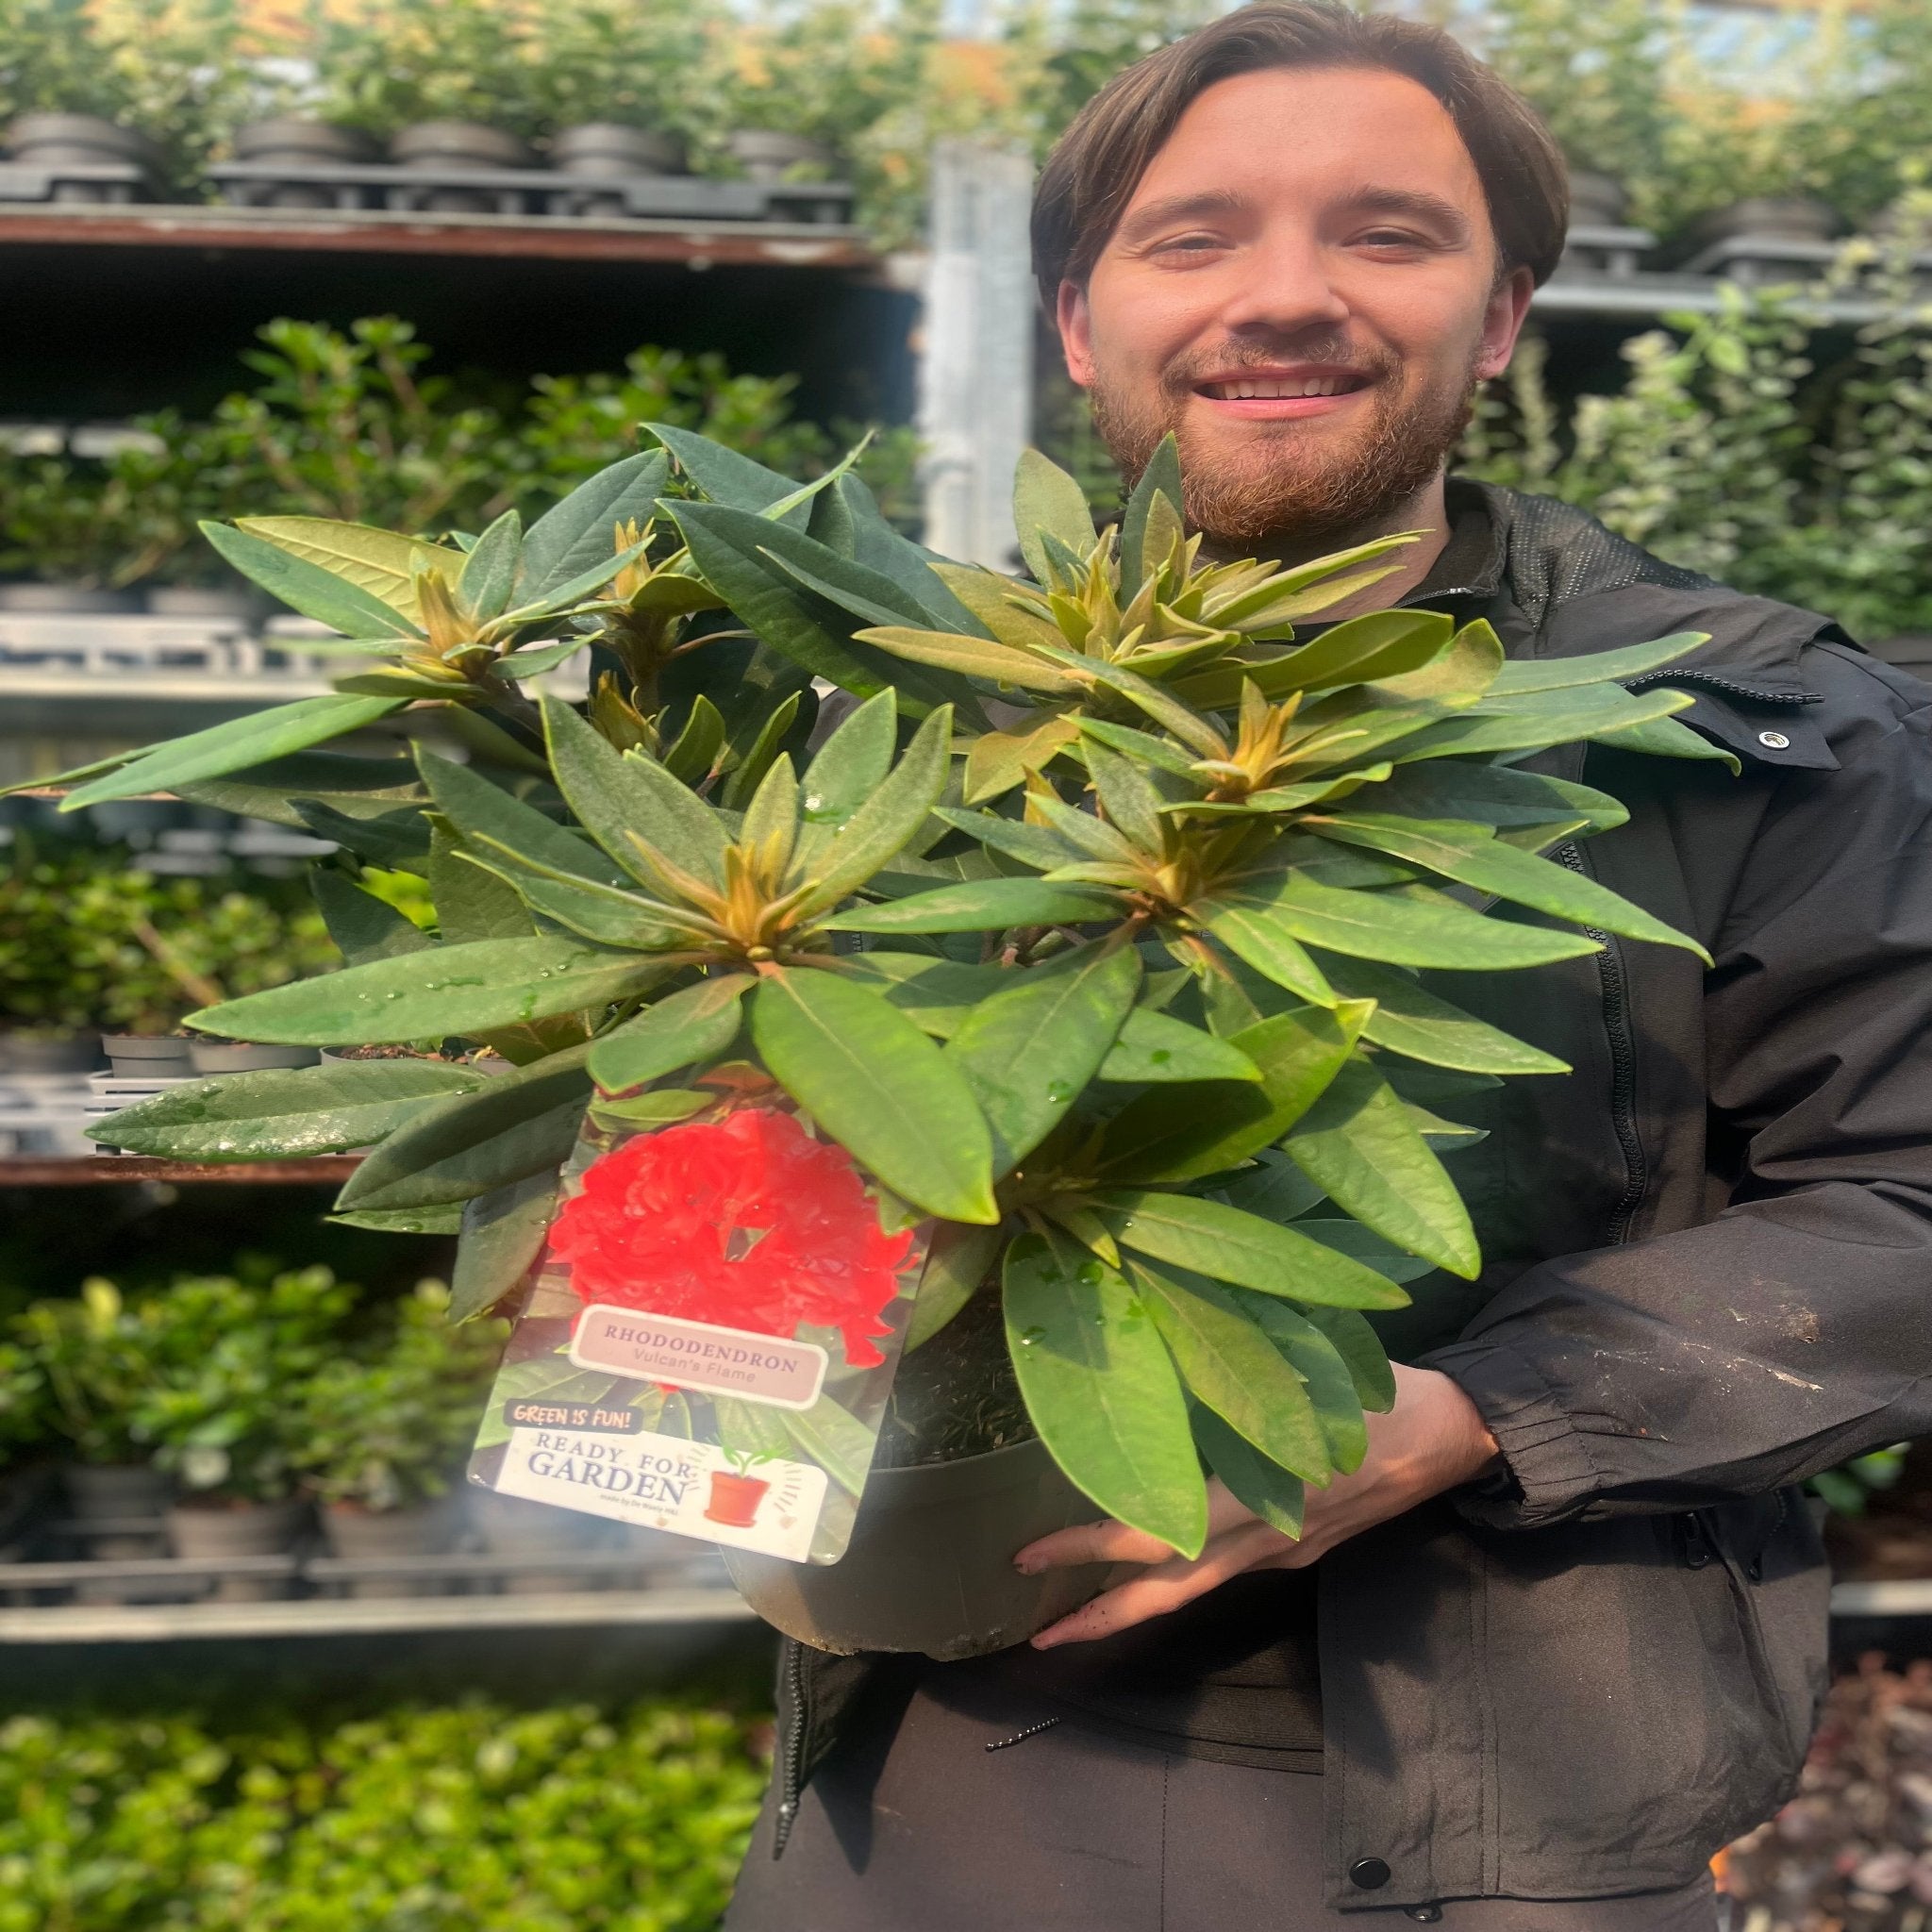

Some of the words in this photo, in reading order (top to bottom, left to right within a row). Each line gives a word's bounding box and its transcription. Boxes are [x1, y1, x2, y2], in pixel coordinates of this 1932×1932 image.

[604, 1324, 798, 1374] RHODODENDRON
[634, 1348, 700, 1372] Vulcan's
[707, 1362, 757, 1383] Flame
[513, 1405, 568, 1424] GREEN
[572, 1408, 589, 1426] IS
[591, 1408, 632, 1429] FUN!
[528, 1451, 690, 1506] GARDEN
[536, 1432, 625, 1463] READY
[639, 1454, 691, 1479] FOR
